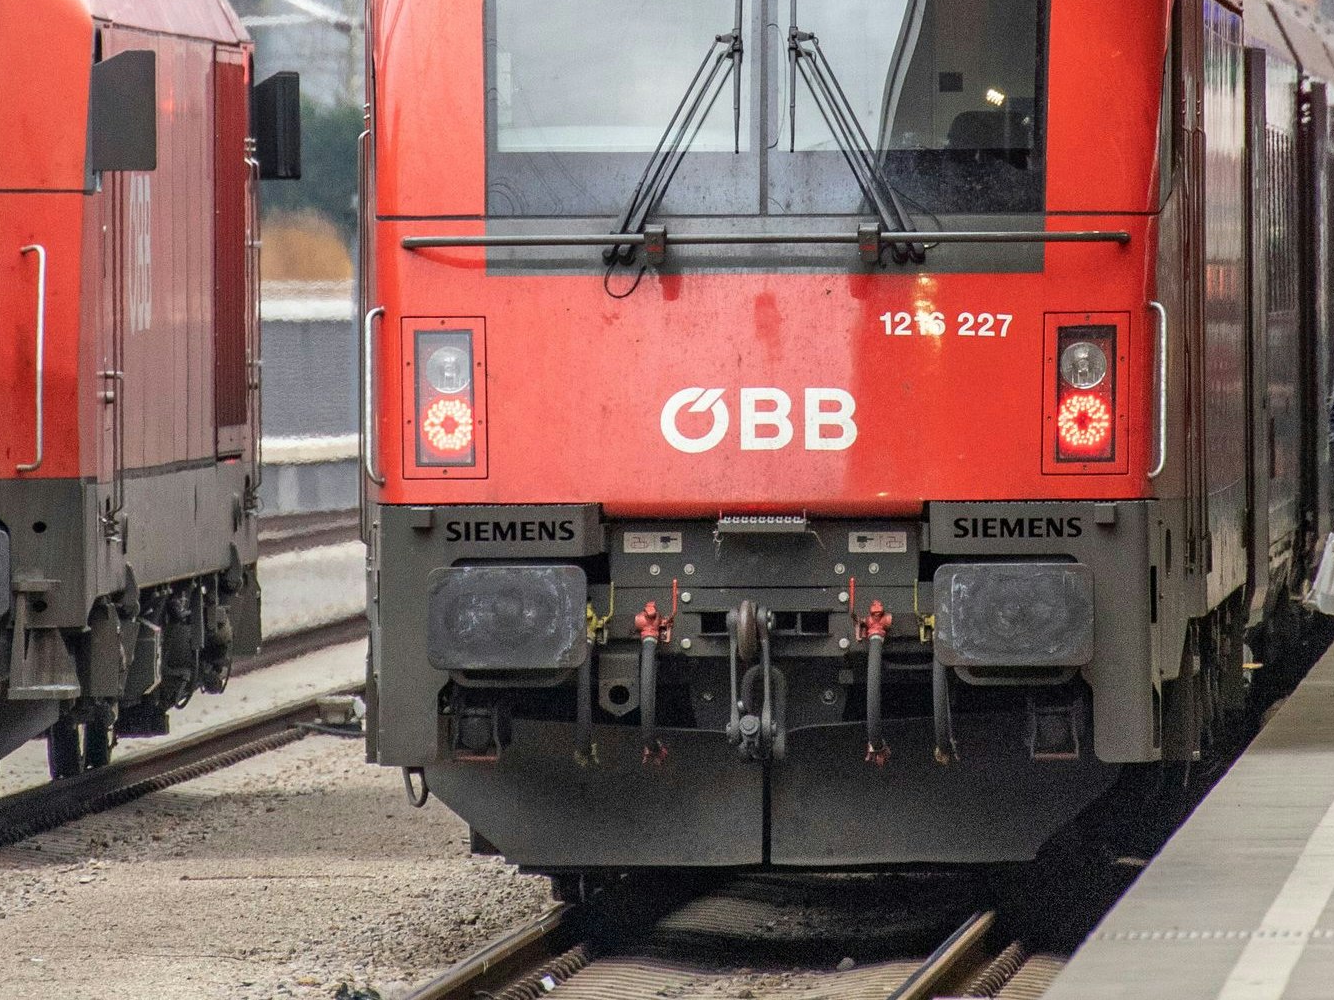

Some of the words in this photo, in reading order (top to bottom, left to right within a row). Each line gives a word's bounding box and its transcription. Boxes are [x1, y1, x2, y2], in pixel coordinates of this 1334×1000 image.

[879, 311, 947, 336] 1216
[957, 312, 1014, 338] 227
[660, 387, 858, 453] ÖBB
[446, 520, 575, 542] SIEMENS
[953, 517, 1083, 539] SIEMENS
